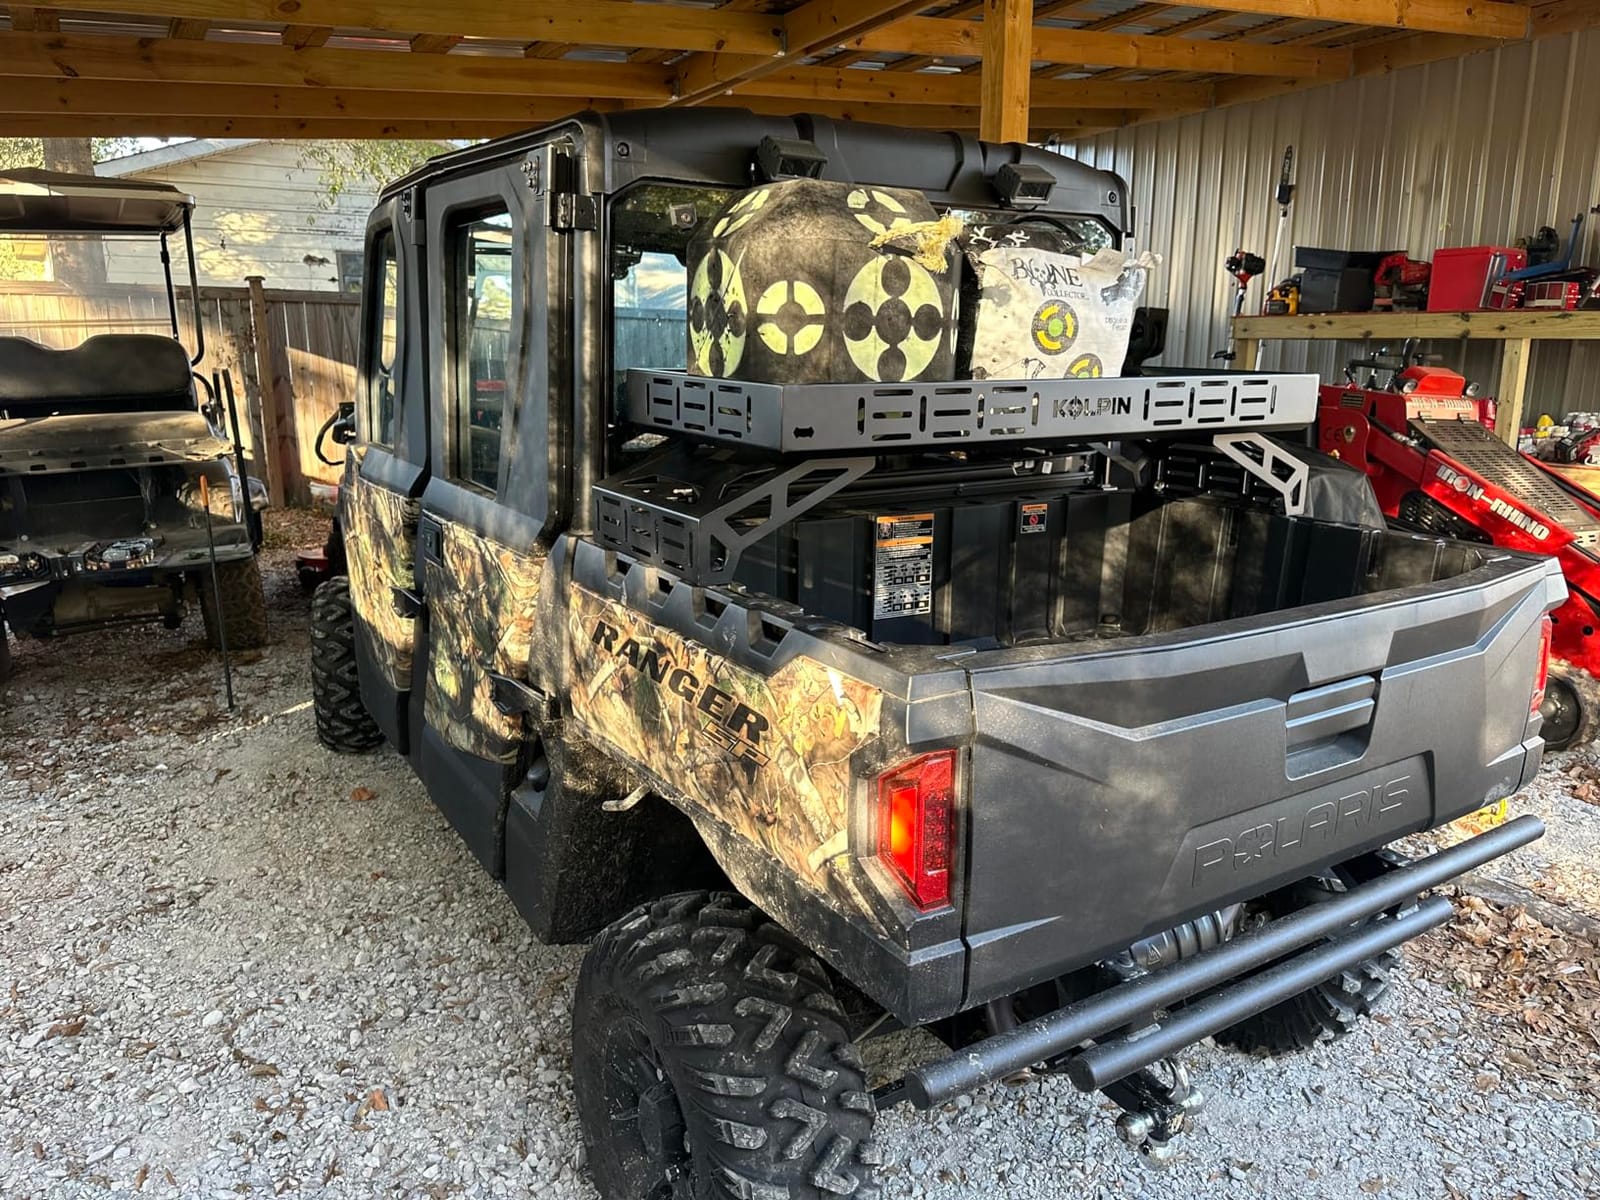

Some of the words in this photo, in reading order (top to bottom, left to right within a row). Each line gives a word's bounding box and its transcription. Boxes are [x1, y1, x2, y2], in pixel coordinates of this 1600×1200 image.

[1053, 396, 1131, 419] KOLPIN
[1436, 464, 1550, 541] IRON-RHINO
[592, 620, 769, 745] RANGER
[1192, 775, 1411, 888] POLARIS
